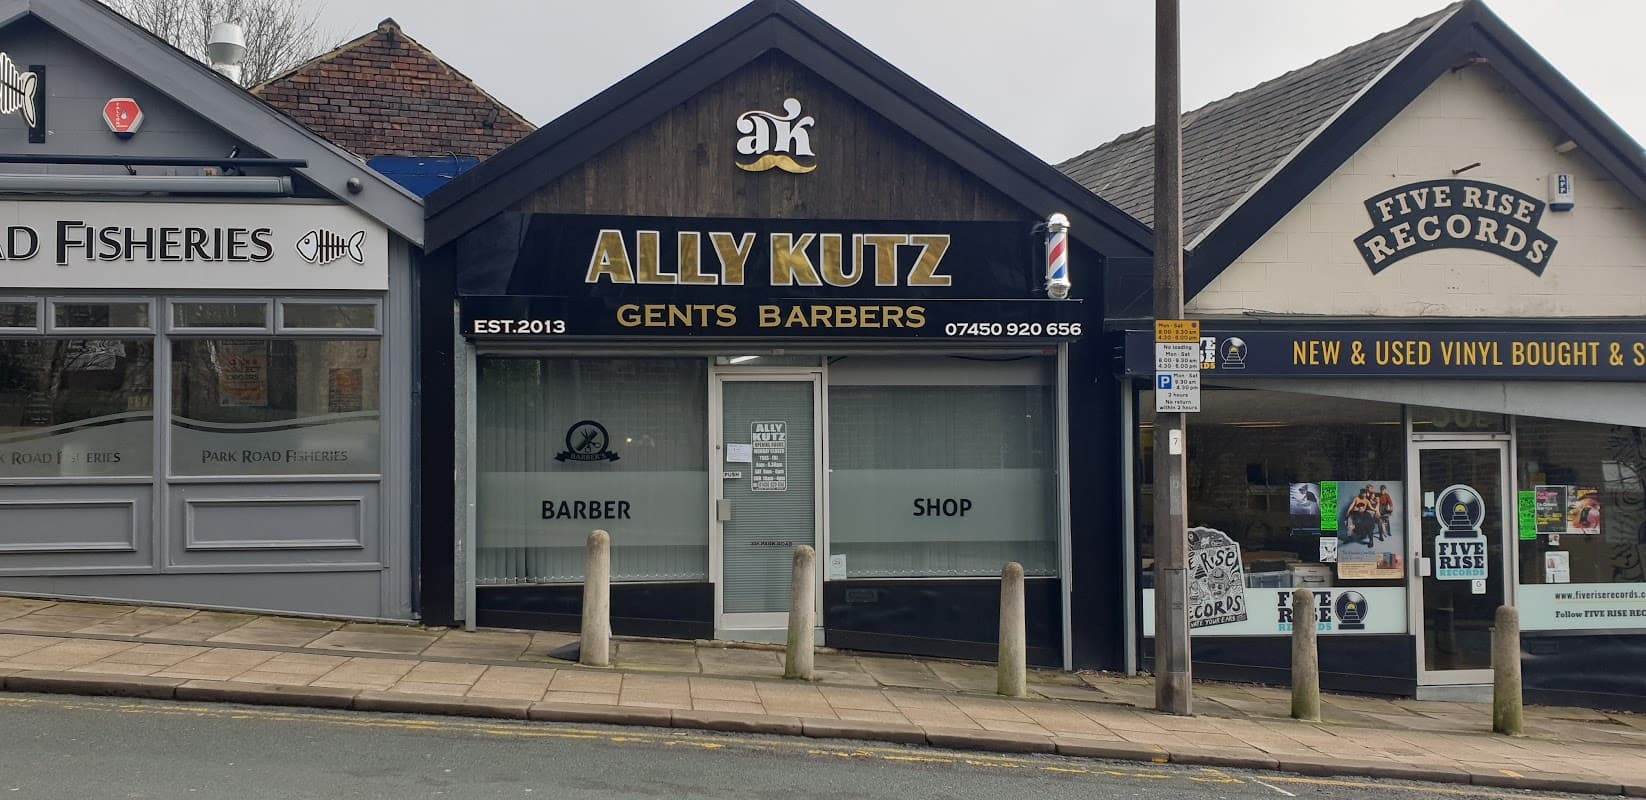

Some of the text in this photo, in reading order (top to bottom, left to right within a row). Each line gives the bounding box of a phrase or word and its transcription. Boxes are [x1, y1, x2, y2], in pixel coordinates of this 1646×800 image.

[1376, 185, 1536, 224] FIVE RISE
[54, 219, 274, 266] FISHERIES
[1363, 214, 1549, 264] RECORDS
[584, 229, 952, 288] ALLY KUTZ
[616, 303, 927, 329] GENTS BARBERS
[473, 318, 567, 335] EST.2013
[944, 322, 1083, 337] 07450 920 656
[1292, 340, 1341, 366] NEW
[1350, 341, 1366, 366] &
[1375, 341, 1431, 366] USED
[1440, 341, 1504, 366] VINYL
[1511, 341, 1600, 366] BOUGHT
[1609, 342, 1625, 367] &
[756, 423, 783, 433] ALLY
[752, 433, 785, 441] KUTZ
[11, 451, 53, 465] ROAD
[56, 450, 121, 465] FERIES
[202, 449, 348, 464] PARK ROAD FISHERIES
[541, 500, 631, 520] BARBER
[912, 498, 972, 517] SHOP
[1438, 542, 1484, 556] FIVE
[1439, 556, 1484, 569] RISE
[1277, 591, 1331, 606] FE
[1278, 607, 1331, 622] RE
[1584, 610, 1605, 618] FIVE
[1607, 609, 1628, 617] RISE
[1279, 623, 1331, 631] REDS
